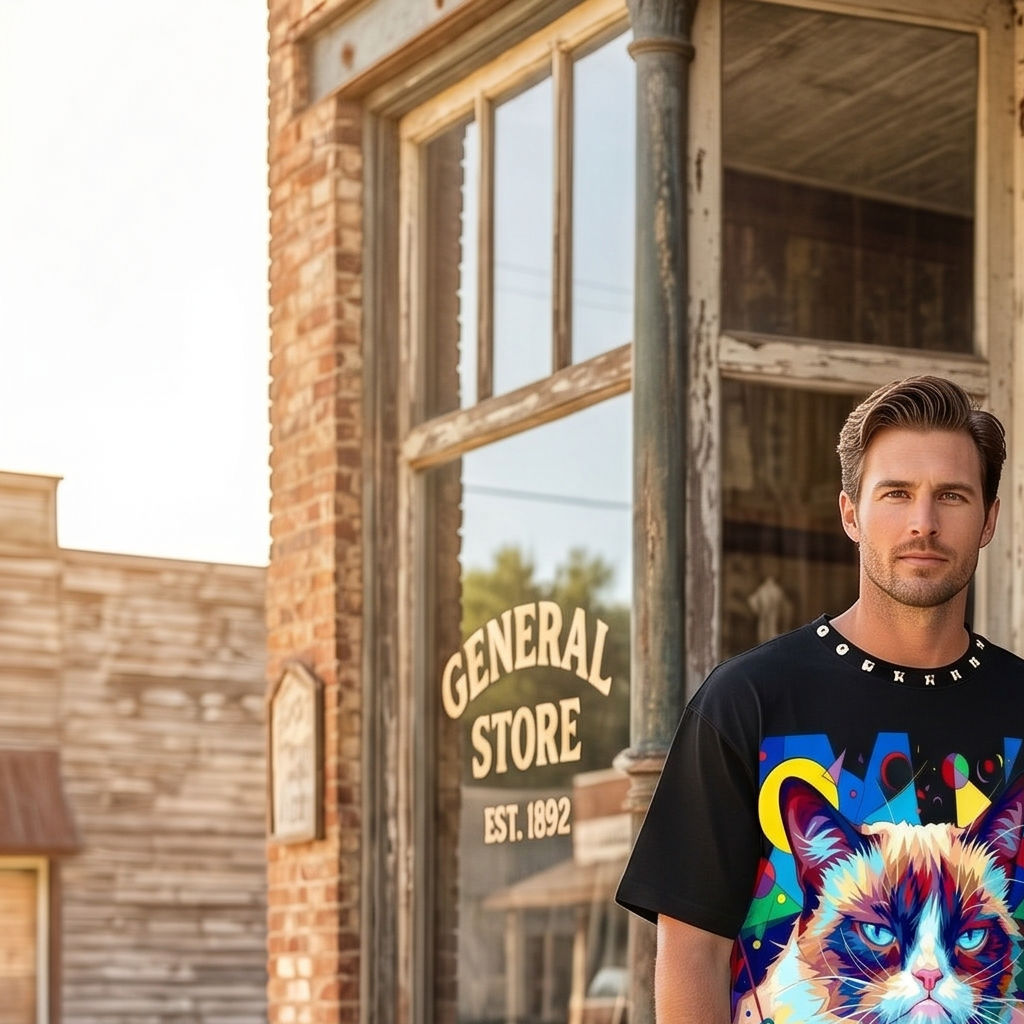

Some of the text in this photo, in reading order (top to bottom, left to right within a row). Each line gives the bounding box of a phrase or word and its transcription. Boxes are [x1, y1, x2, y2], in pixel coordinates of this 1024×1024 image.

[442, 601, 613, 719] GENERAL
[471, 697, 582, 779] STORE
[484, 797, 571, 844] EST. 1892
